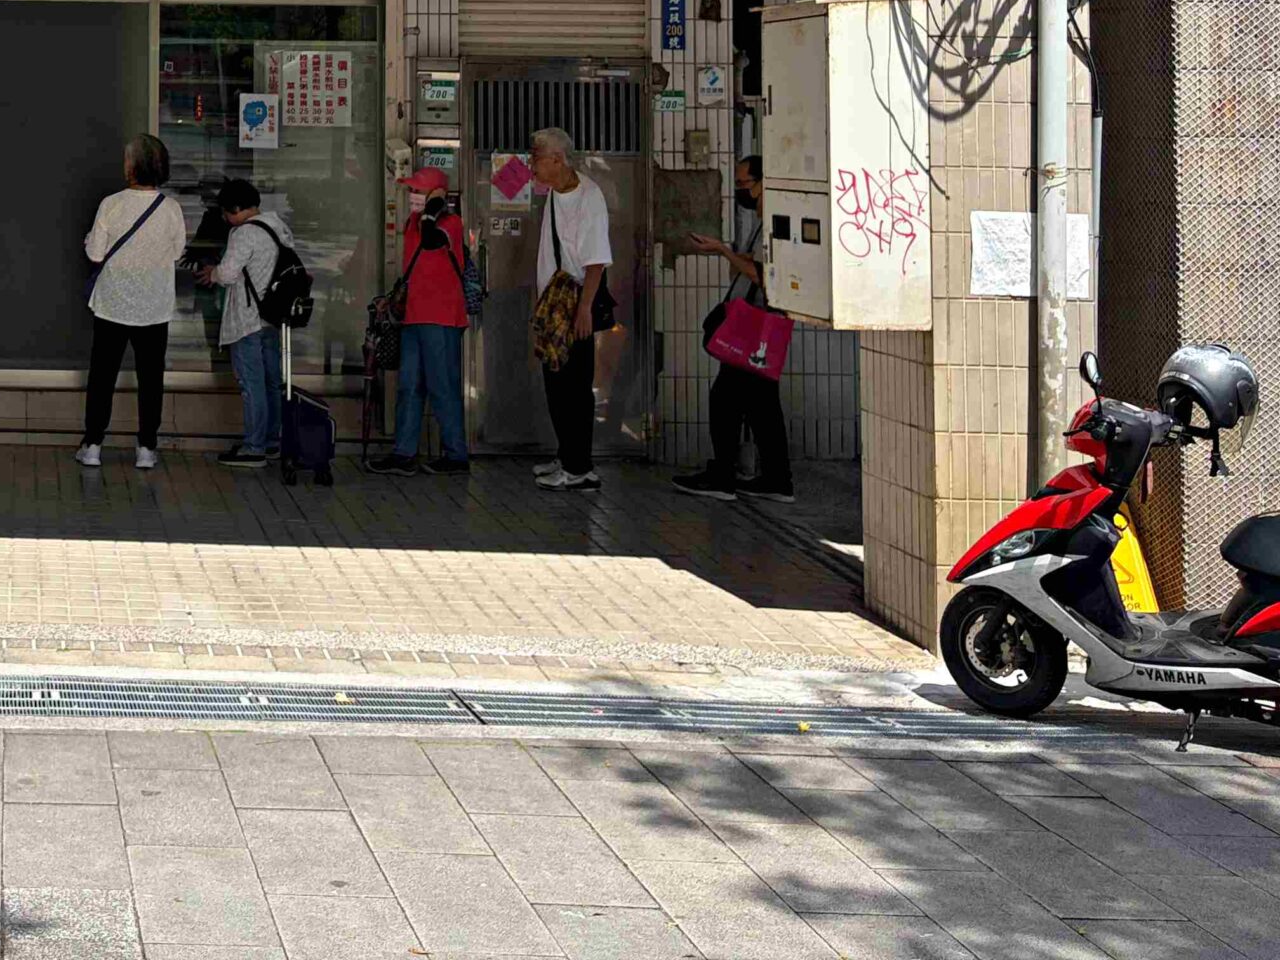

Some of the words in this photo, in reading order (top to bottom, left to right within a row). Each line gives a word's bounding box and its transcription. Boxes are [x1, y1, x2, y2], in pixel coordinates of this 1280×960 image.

[430, 89, 447, 99] 200
[660, 100, 677, 109] 200
[1144, 669, 1207, 685] YAMAHA
